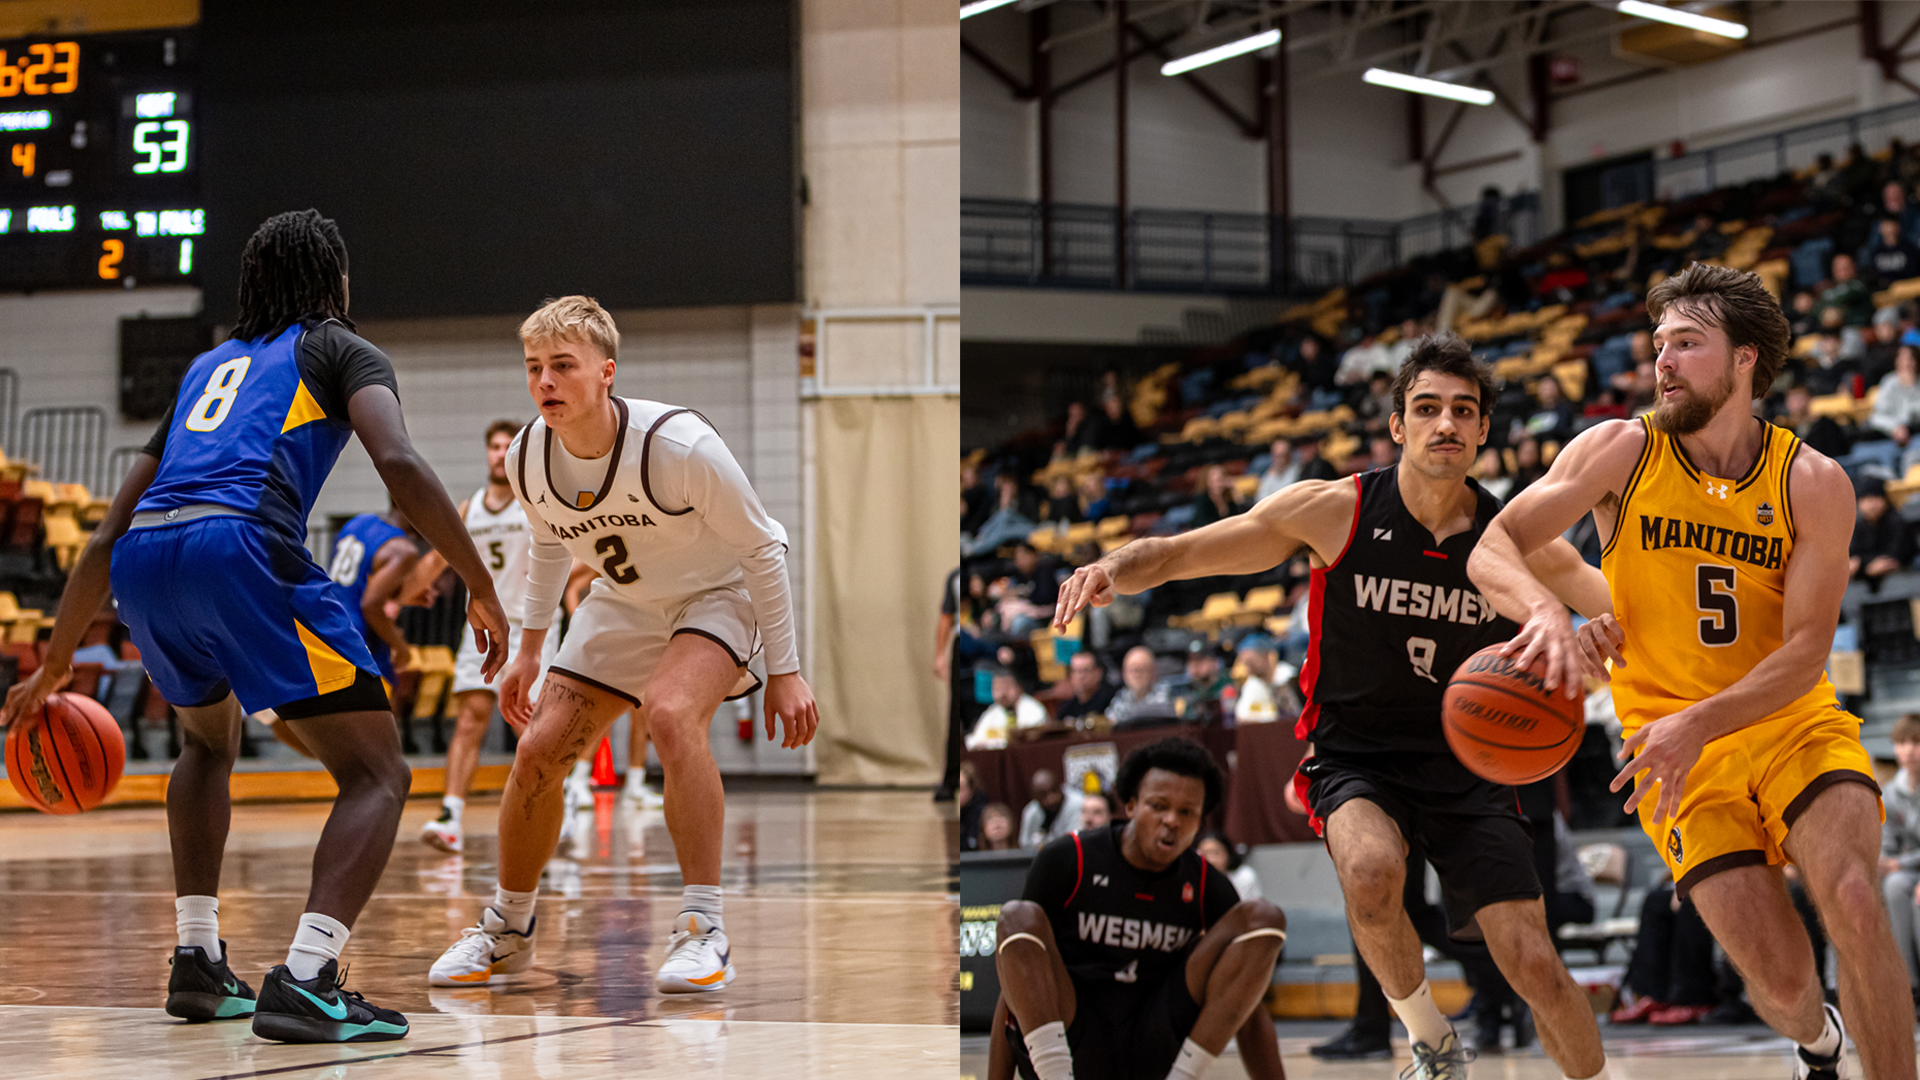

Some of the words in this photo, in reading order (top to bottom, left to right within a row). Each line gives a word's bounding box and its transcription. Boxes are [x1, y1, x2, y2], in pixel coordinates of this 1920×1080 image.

[12, 143, 36, 177] 4
[132, 119, 190, 174] 53
[98, 239, 124, 280] 2
[179, 238, 193, 274] 1
[185, 356, 251, 432] 8
[545, 514, 657, 540] MANITOBA
[1639, 515, 1783, 570] MANITOBA
[488, 541, 505, 570] 5
[594, 534, 641, 585] 2
[1695, 563, 1740, 647] 5
